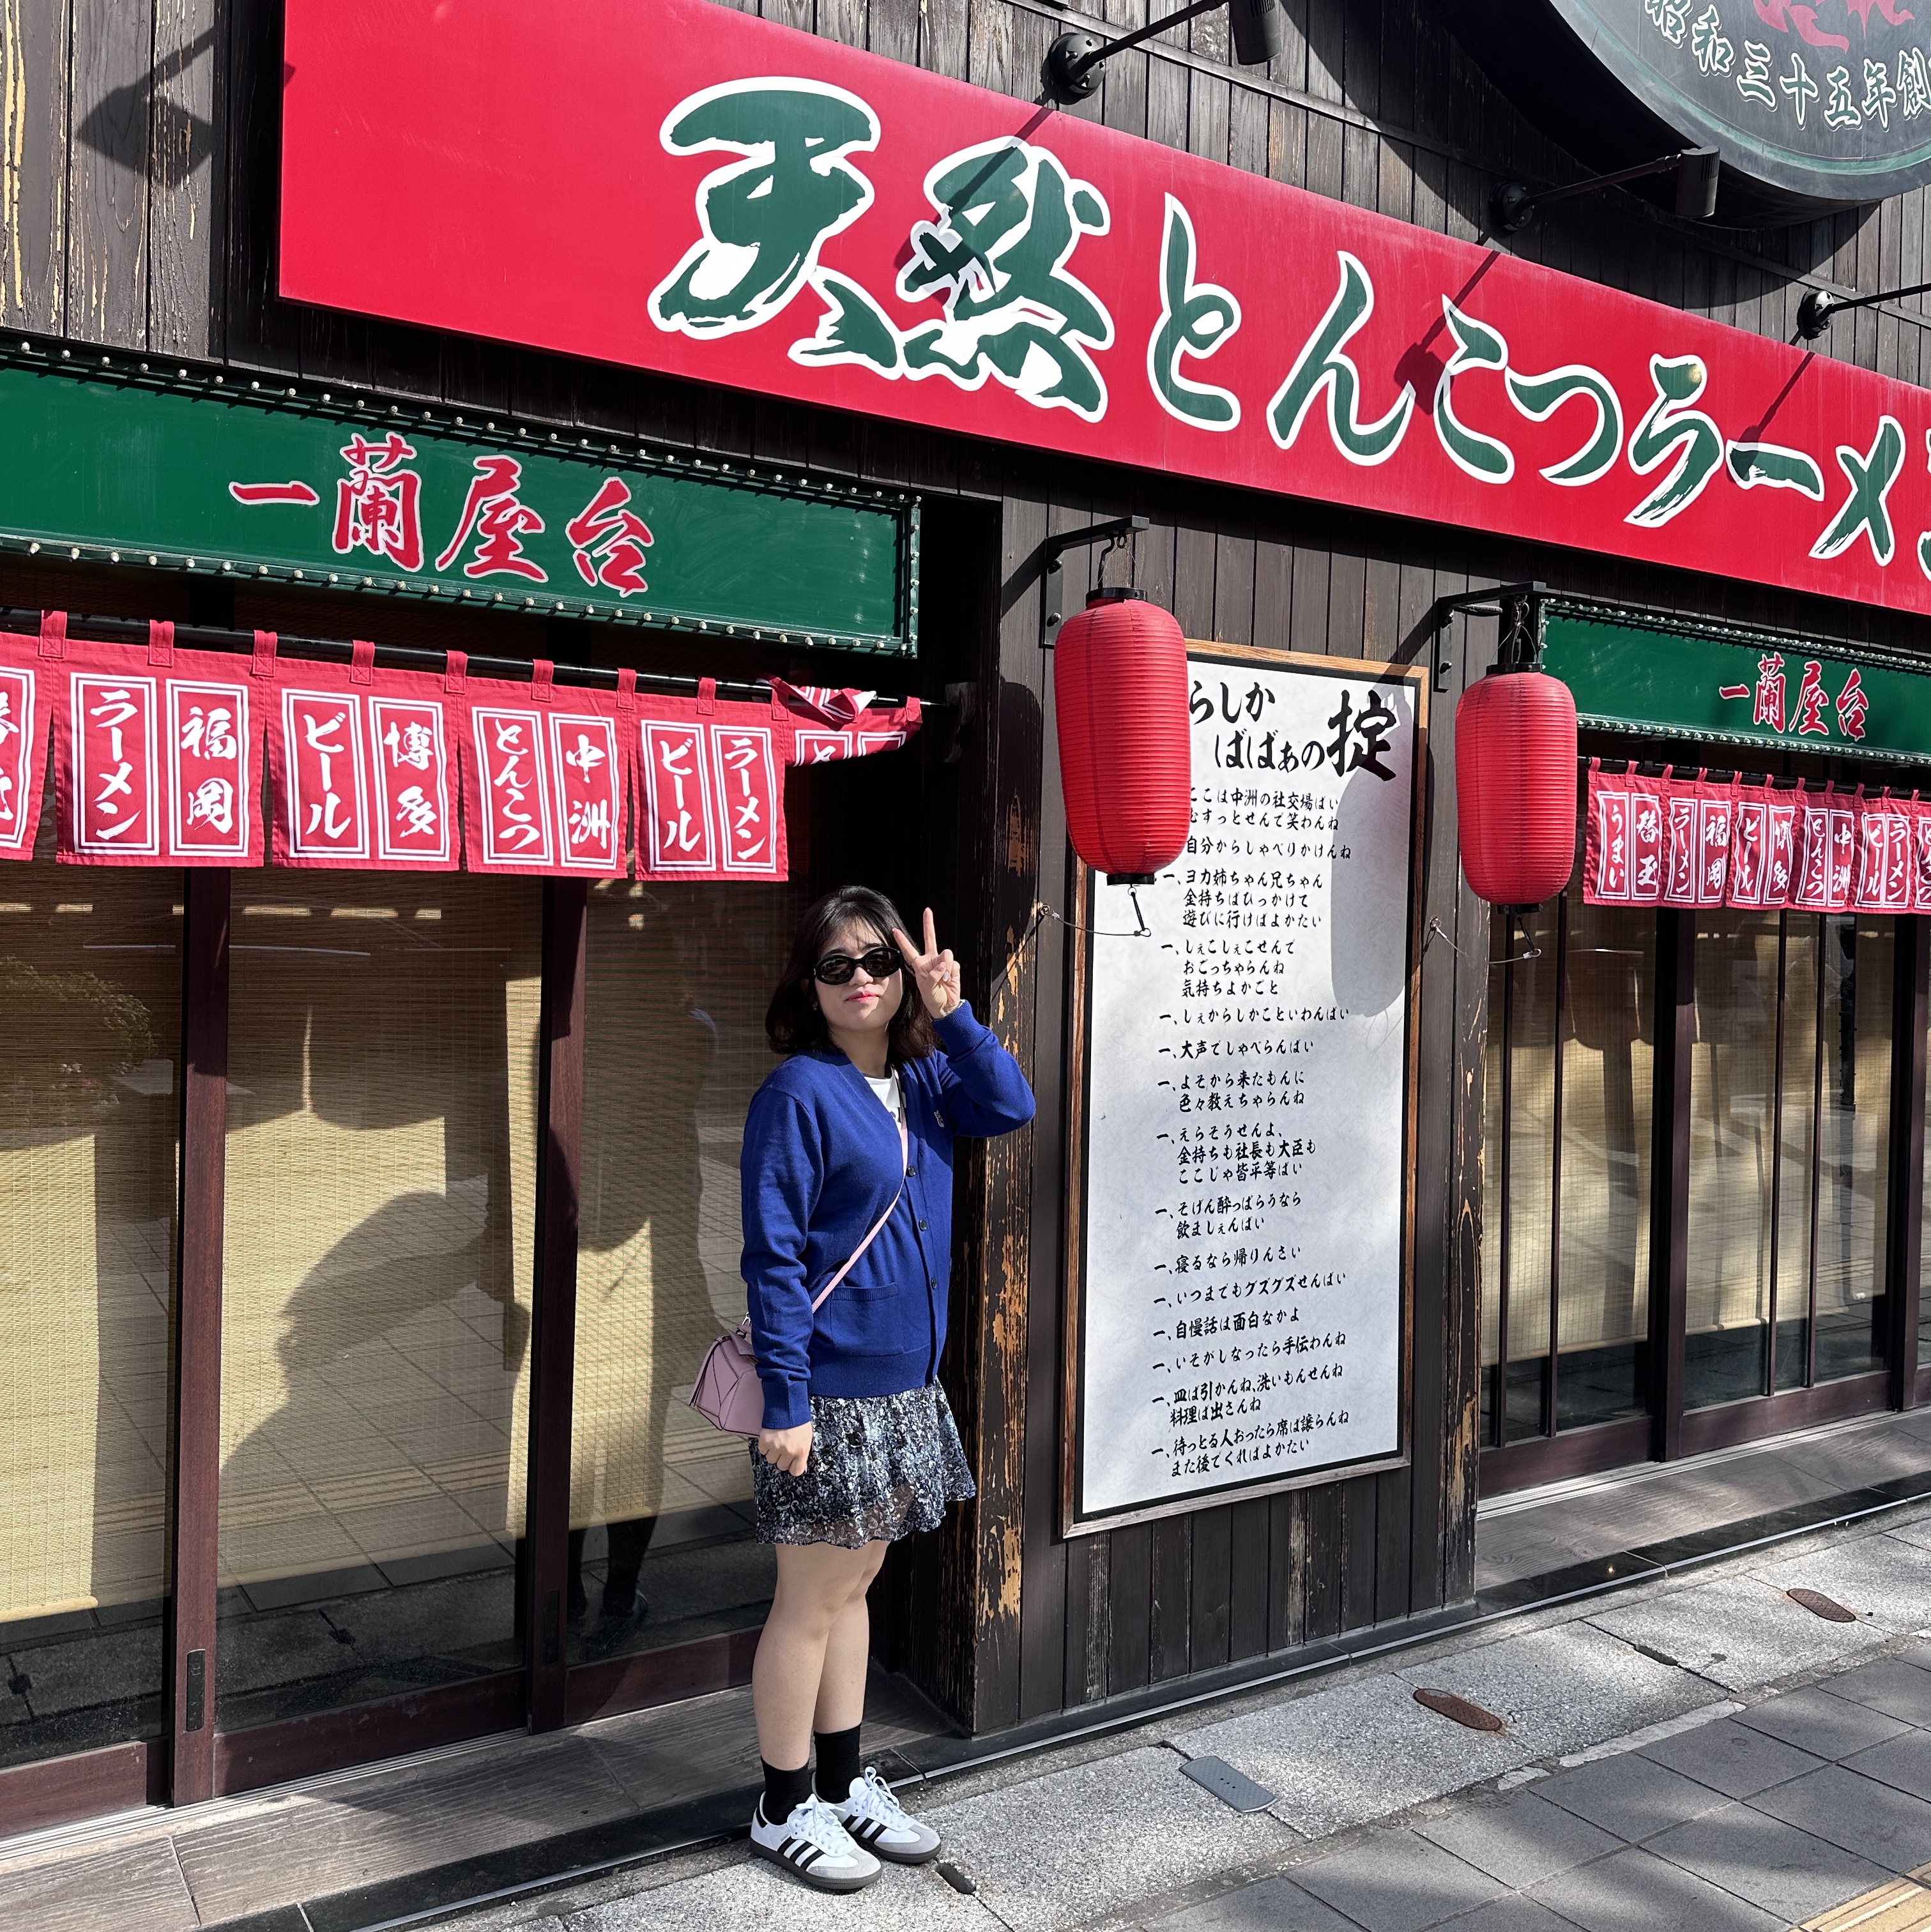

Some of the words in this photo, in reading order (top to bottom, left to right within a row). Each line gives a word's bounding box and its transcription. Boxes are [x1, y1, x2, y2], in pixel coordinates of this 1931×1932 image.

[1645, 0, 1931, 128] 昭和三十五年創
[647, 77, 1931, 582] 天然とんこつラーメ
[229, 432, 654, 598] 一蘭屋台
[1718, 651, 1868, 741] 一蘭屋台
[91, 689, 141, 840] ラーメン
[181, 707, 238, 834] 福岡
[304, 712, 352, 839] ビール
[383, 721, 437, 837] 博多
[494, 719, 540, 850] とんこつ
[566, 734, 611, 849] 中洲
[660, 738, 701, 852] ビール
[724, 738, 766, 860] ラーメン
[1608, 804, 1624, 888] うまい
[1637, 810, 1659, 886] 替玉
[1674, 807, 1690, 894] ラーメン
[1706, 815, 1727, 890] 福岡
[1741, 816, 1760, 892] ビール
[1806, 818, 1825, 897] とんこつ
[1833, 823, 1852, 894] 中洲
[1865, 823, 1883, 896] ビール
[1887, 823, 1906, 901] ラーメン
